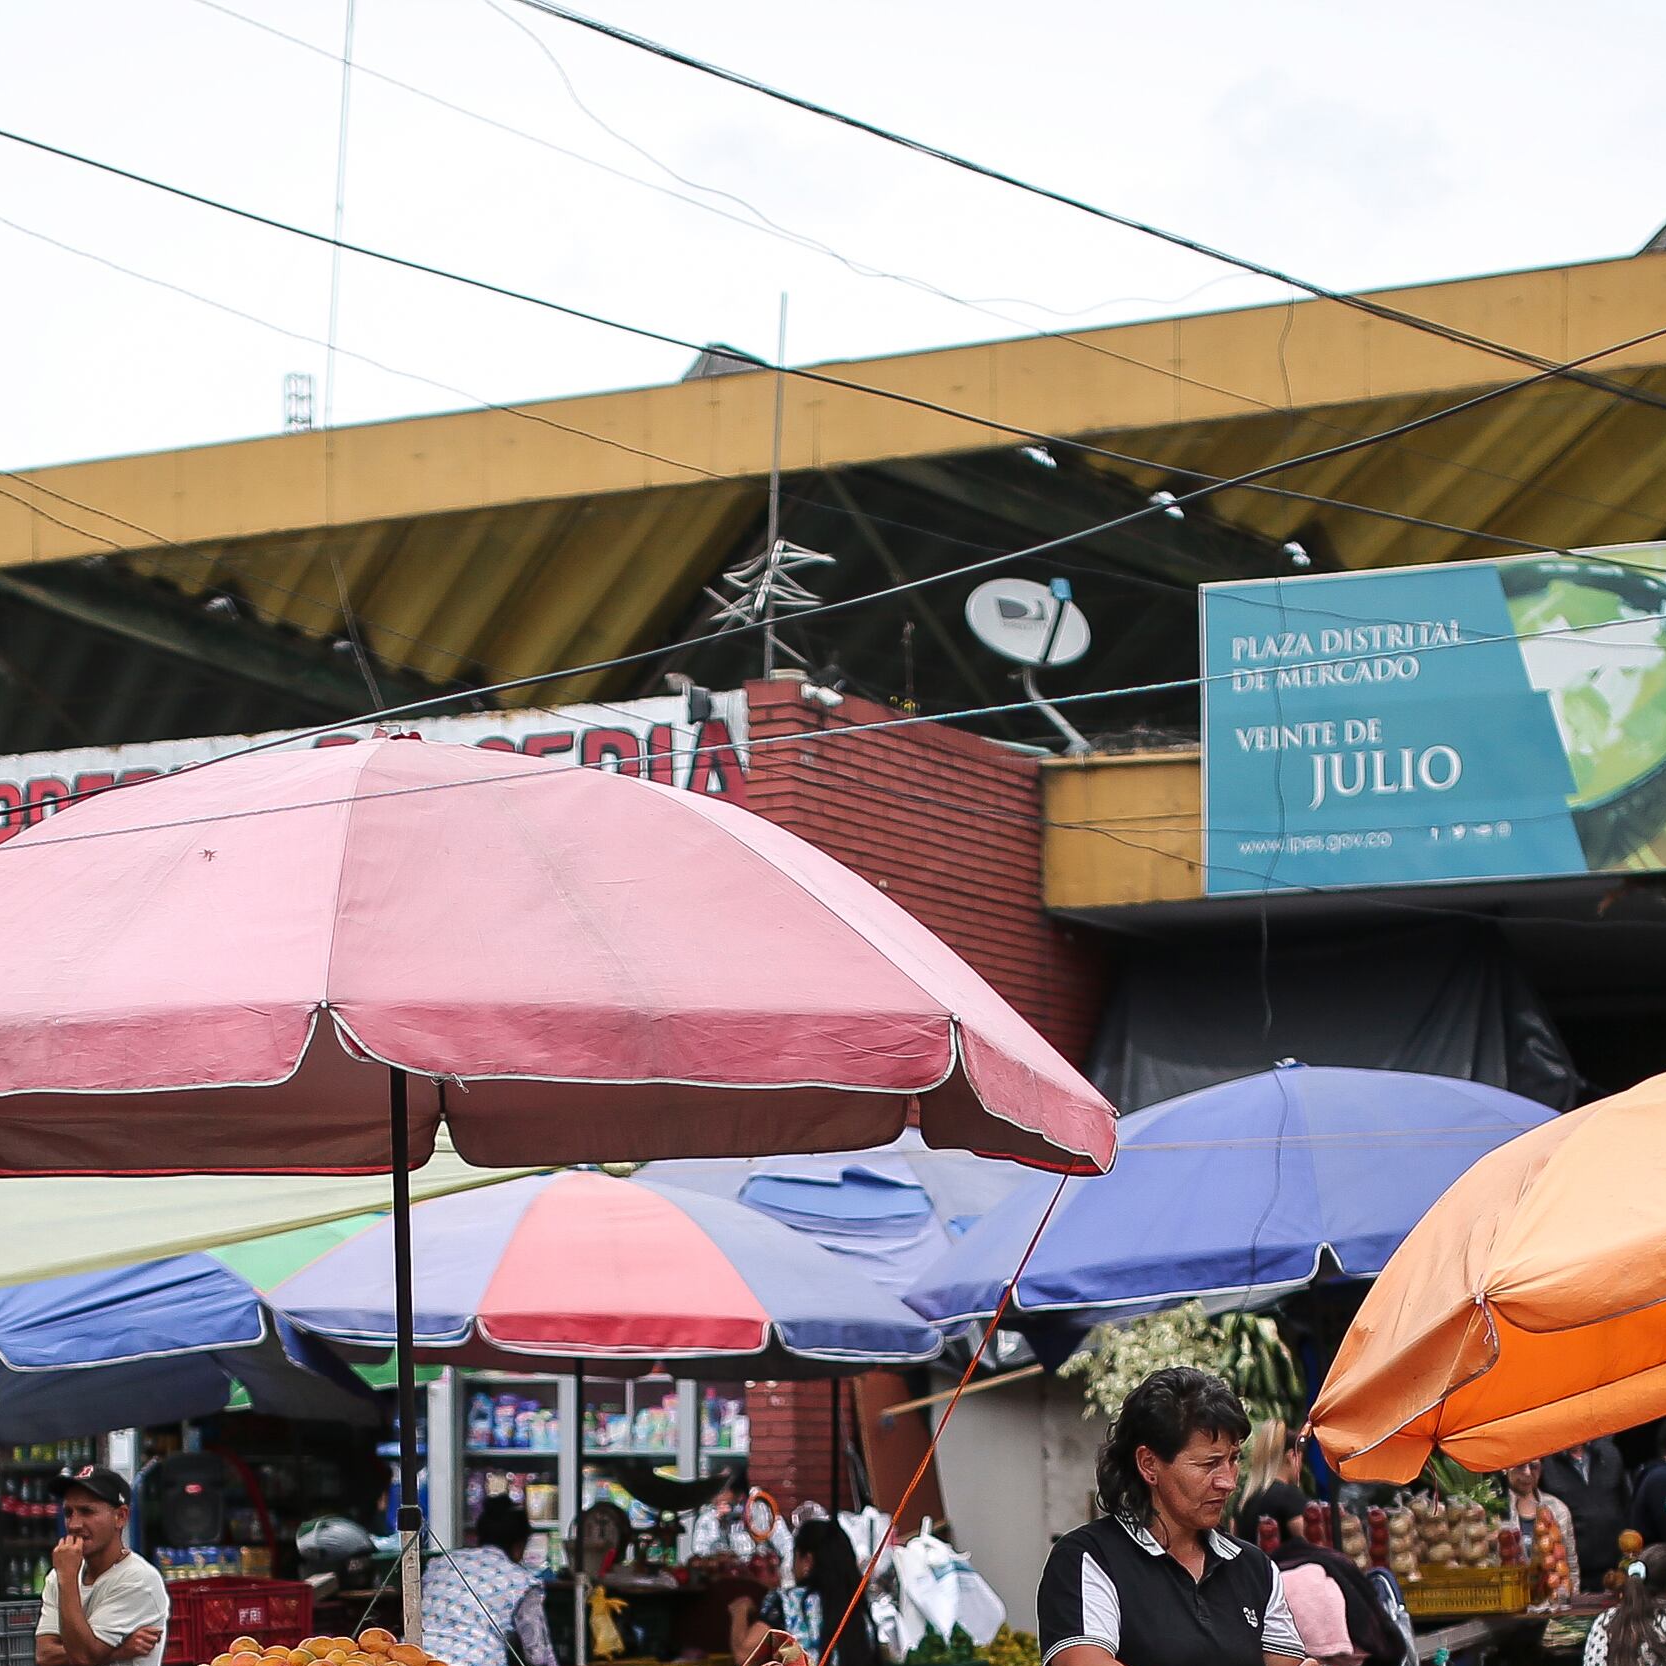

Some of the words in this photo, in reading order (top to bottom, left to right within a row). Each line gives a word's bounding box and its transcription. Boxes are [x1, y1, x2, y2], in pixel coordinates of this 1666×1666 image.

[1232, 631, 1314, 661] PLAZA
[1320, 619, 1462, 654] DISTRITAL
[1232, 667, 1269, 692] DE
[1277, 655, 1421, 690] MERCADO
[1235, 720, 1337, 752] VEINTE
[1344, 717, 1382, 744] DE
[1308, 745, 1462, 811] JULIO
